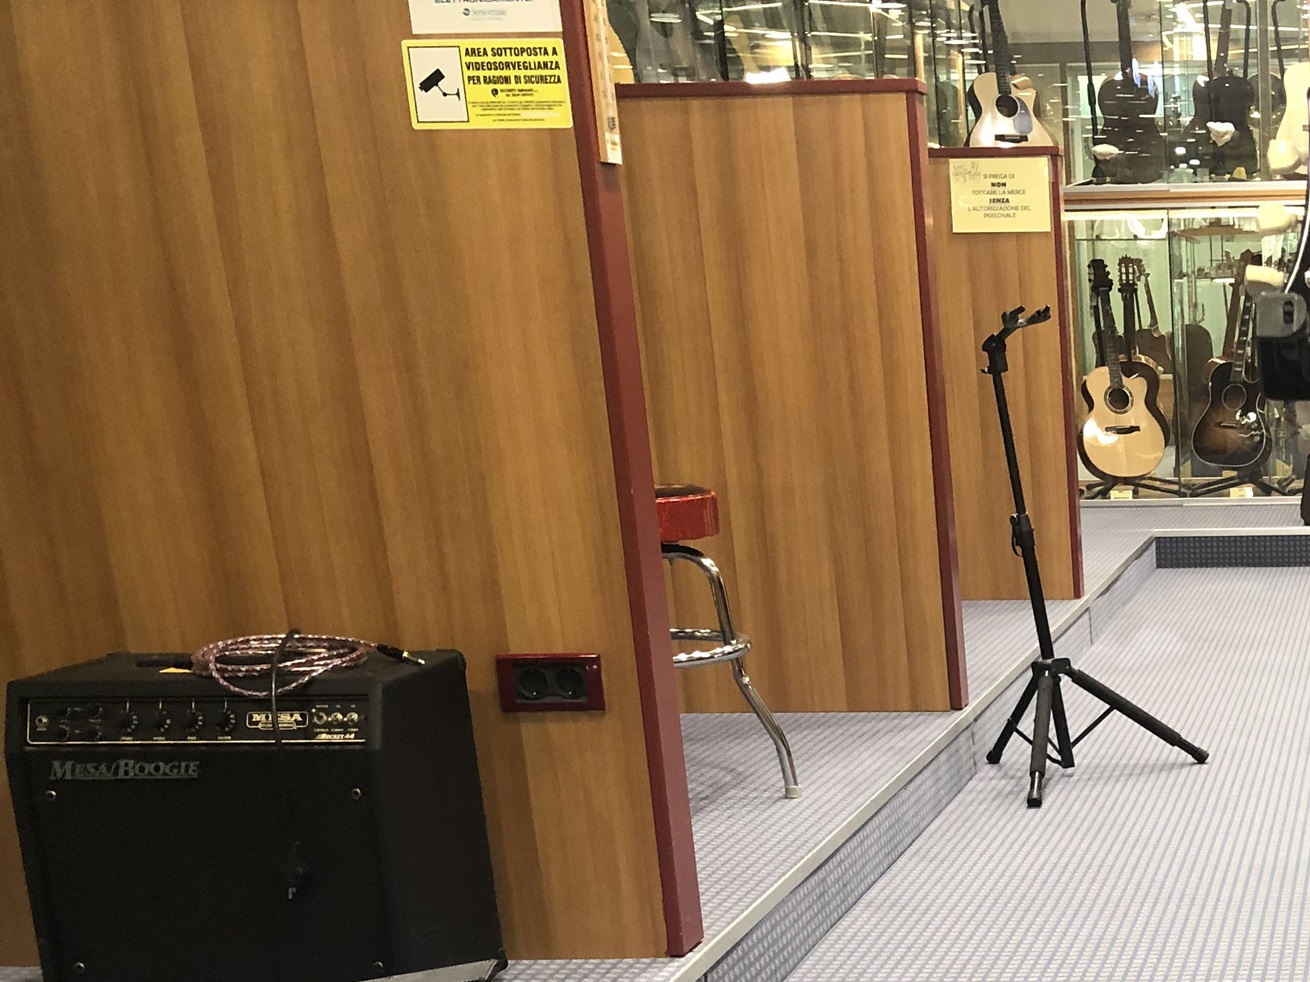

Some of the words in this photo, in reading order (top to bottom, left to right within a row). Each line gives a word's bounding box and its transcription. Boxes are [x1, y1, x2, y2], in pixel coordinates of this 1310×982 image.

[465, 47, 488, 57] AREA
[491, 47, 549, 57] SOTTOPOSTA
[552, 46, 558, 56] A
[465, 60, 560, 71] VIDEOSORVEGLIANZA
[467, 75, 481, 85] PER
[483, 75, 511, 85] RAGIONI
[514, 75, 521, 84] DI
[523, 75, 561, 84] SICUREZZA
